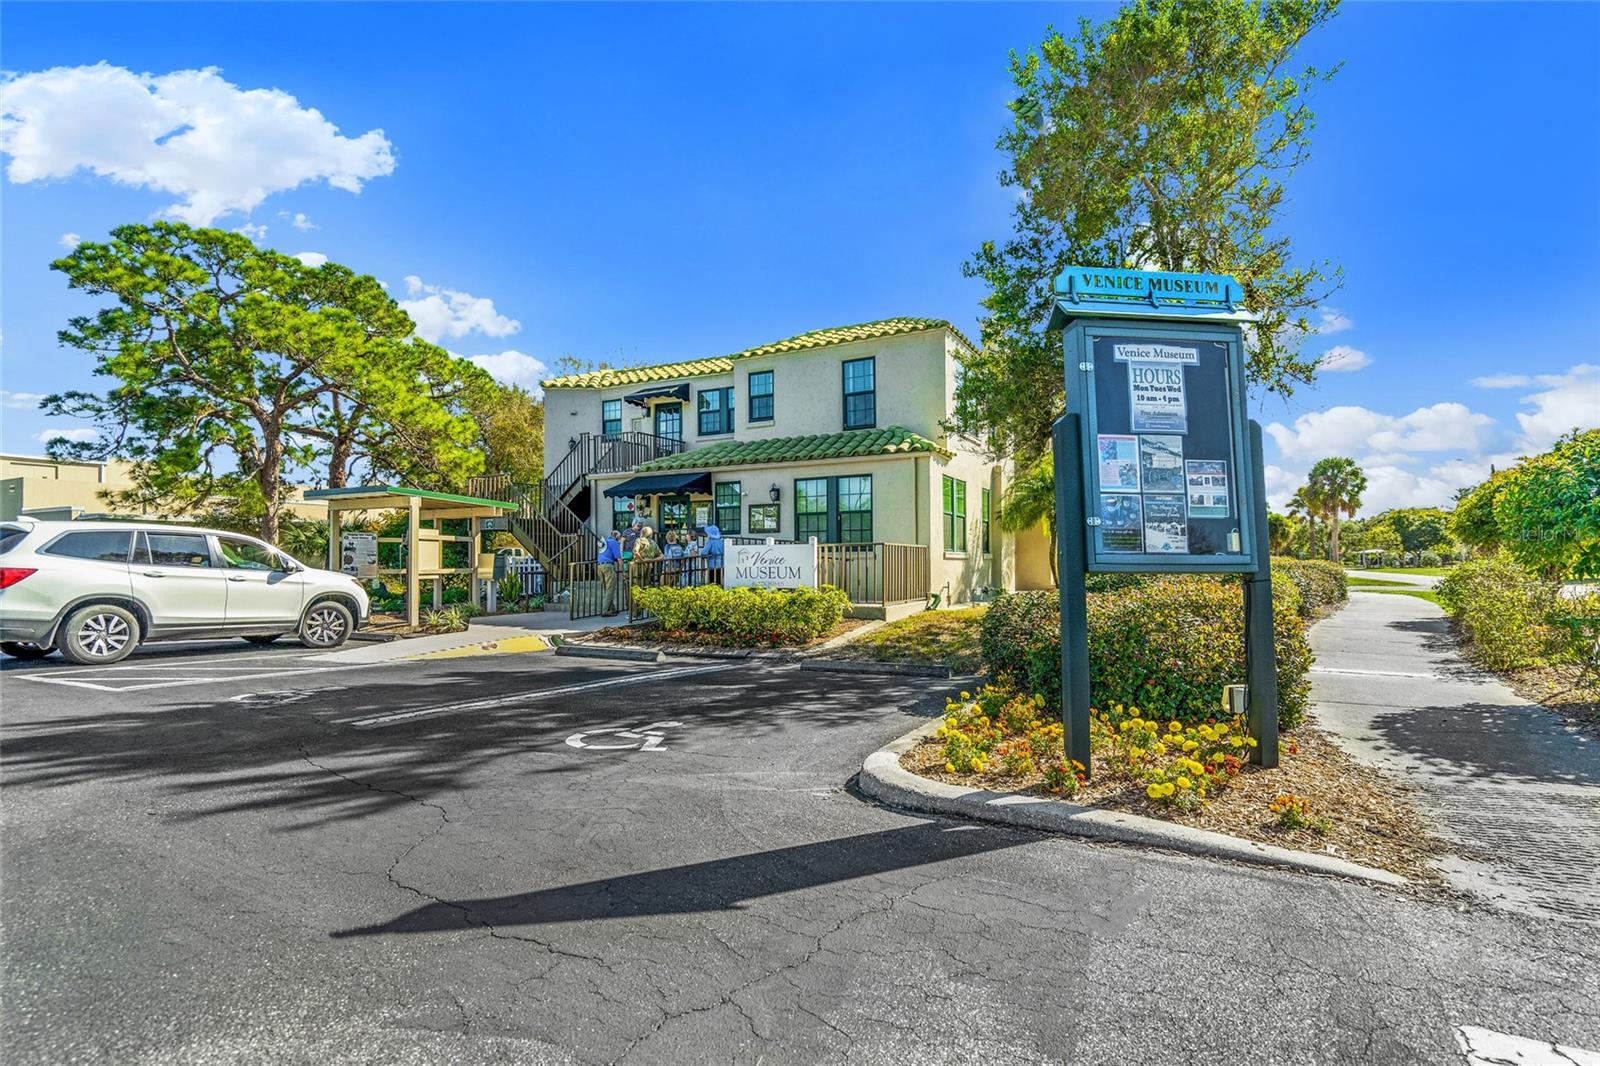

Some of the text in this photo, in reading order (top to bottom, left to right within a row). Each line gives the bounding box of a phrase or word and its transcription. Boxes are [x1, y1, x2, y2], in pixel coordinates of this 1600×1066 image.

[1082, 274, 1219, 294] VENICE MUSEUM
[1116, 346, 1196, 360] Venice Museum
[1131, 368, 1182, 385] HOURS
[751, 549, 785, 566] Venice
[736, 567, 802, 579] MUSEUM
